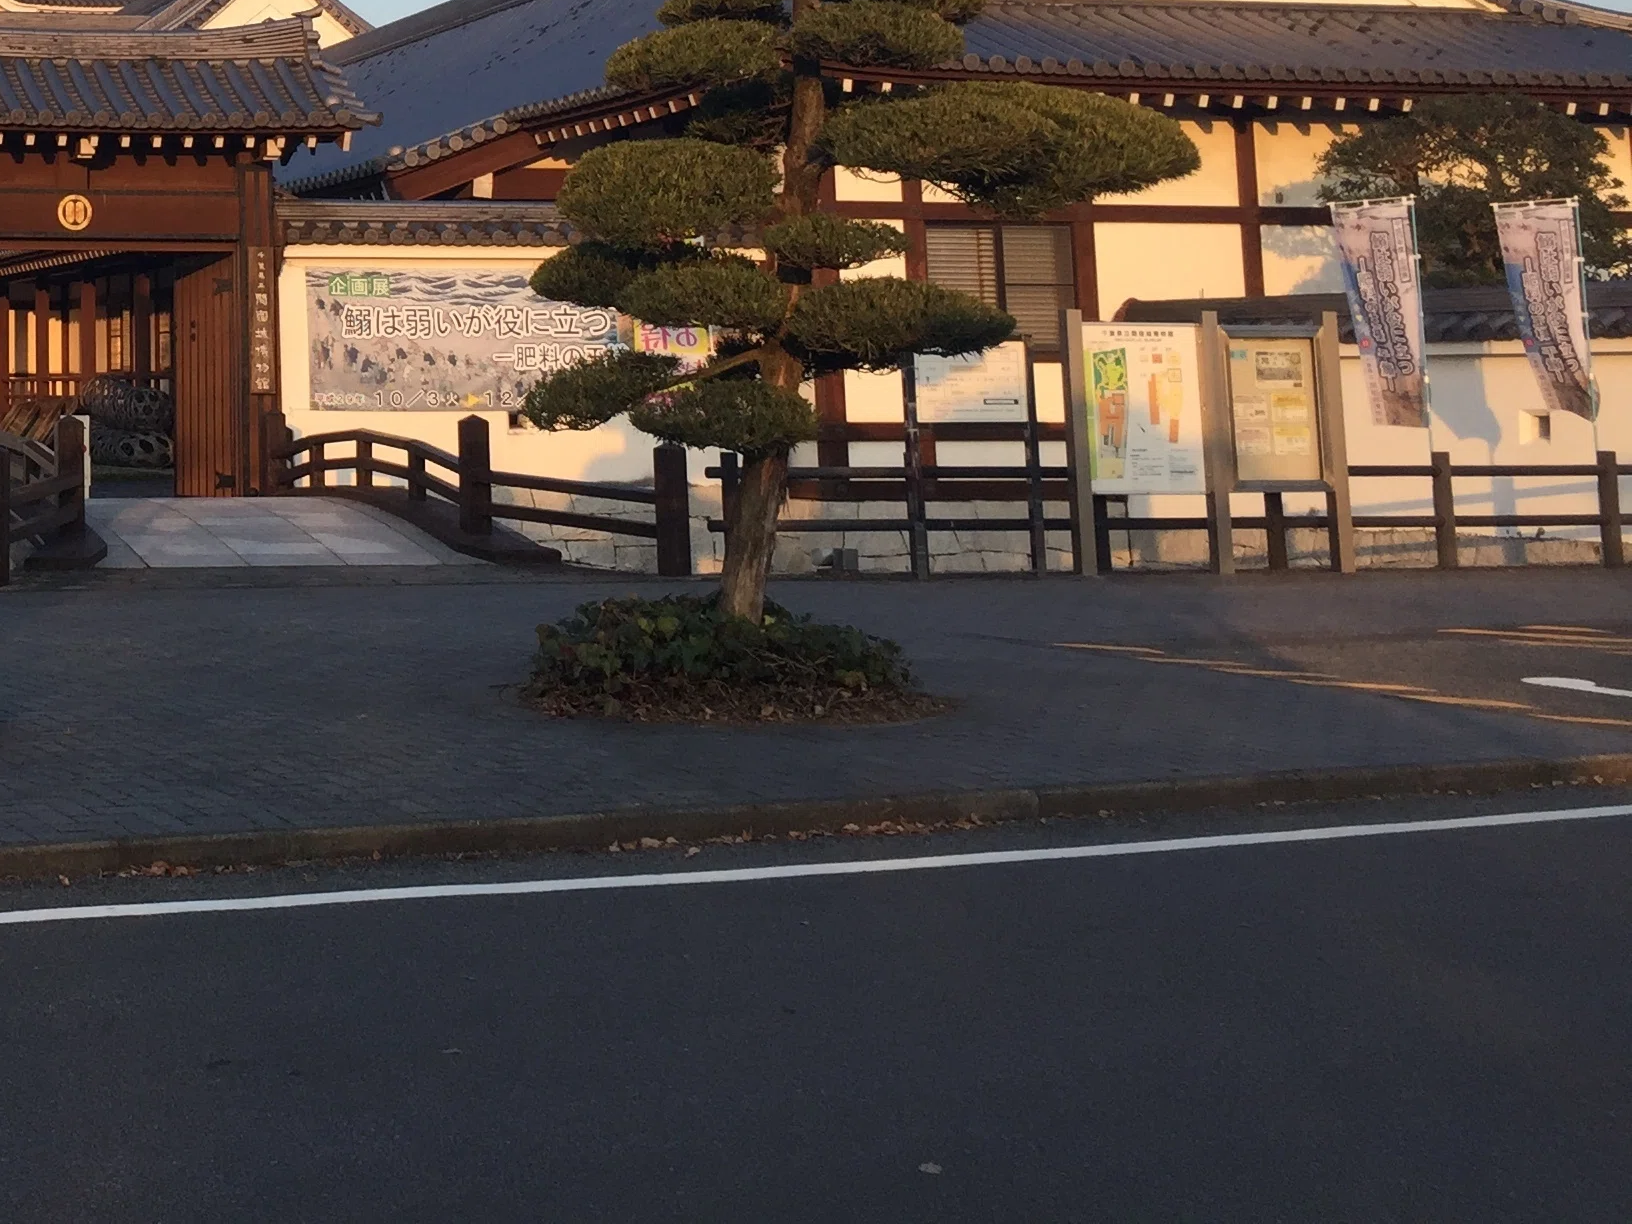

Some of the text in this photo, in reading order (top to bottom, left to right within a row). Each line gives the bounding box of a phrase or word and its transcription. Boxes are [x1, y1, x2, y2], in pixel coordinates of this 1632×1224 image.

[329, 276, 389, 296] 企画展
[342, 305, 611, 338] 鰯は弱いが役に立つ
